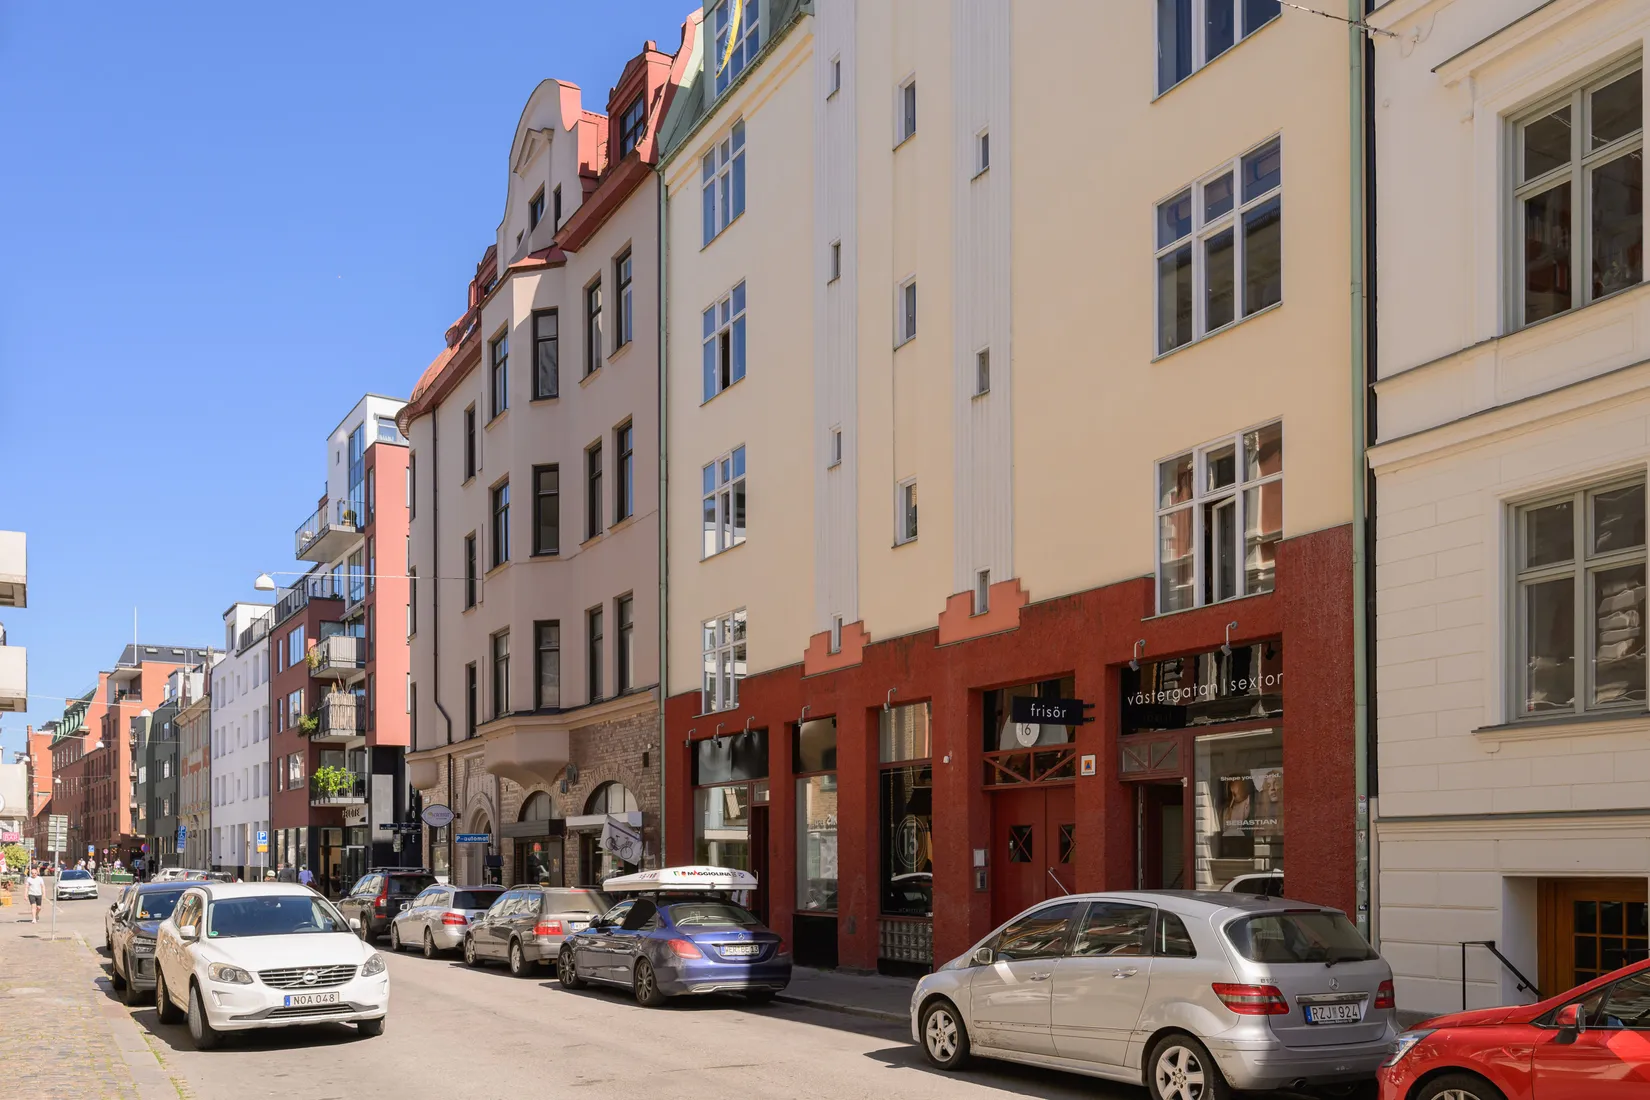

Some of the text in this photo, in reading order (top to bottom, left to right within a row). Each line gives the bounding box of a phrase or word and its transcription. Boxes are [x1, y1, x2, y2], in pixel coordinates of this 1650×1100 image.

[1127, 683, 1218, 706] västergatan
[1030, 703, 1067, 718] frisör
[1021, 723, 1032, 736] 16
[294, 994, 335, 1005] NOA 048
[1311, 1005, 1358, 1020] RZJ 924
